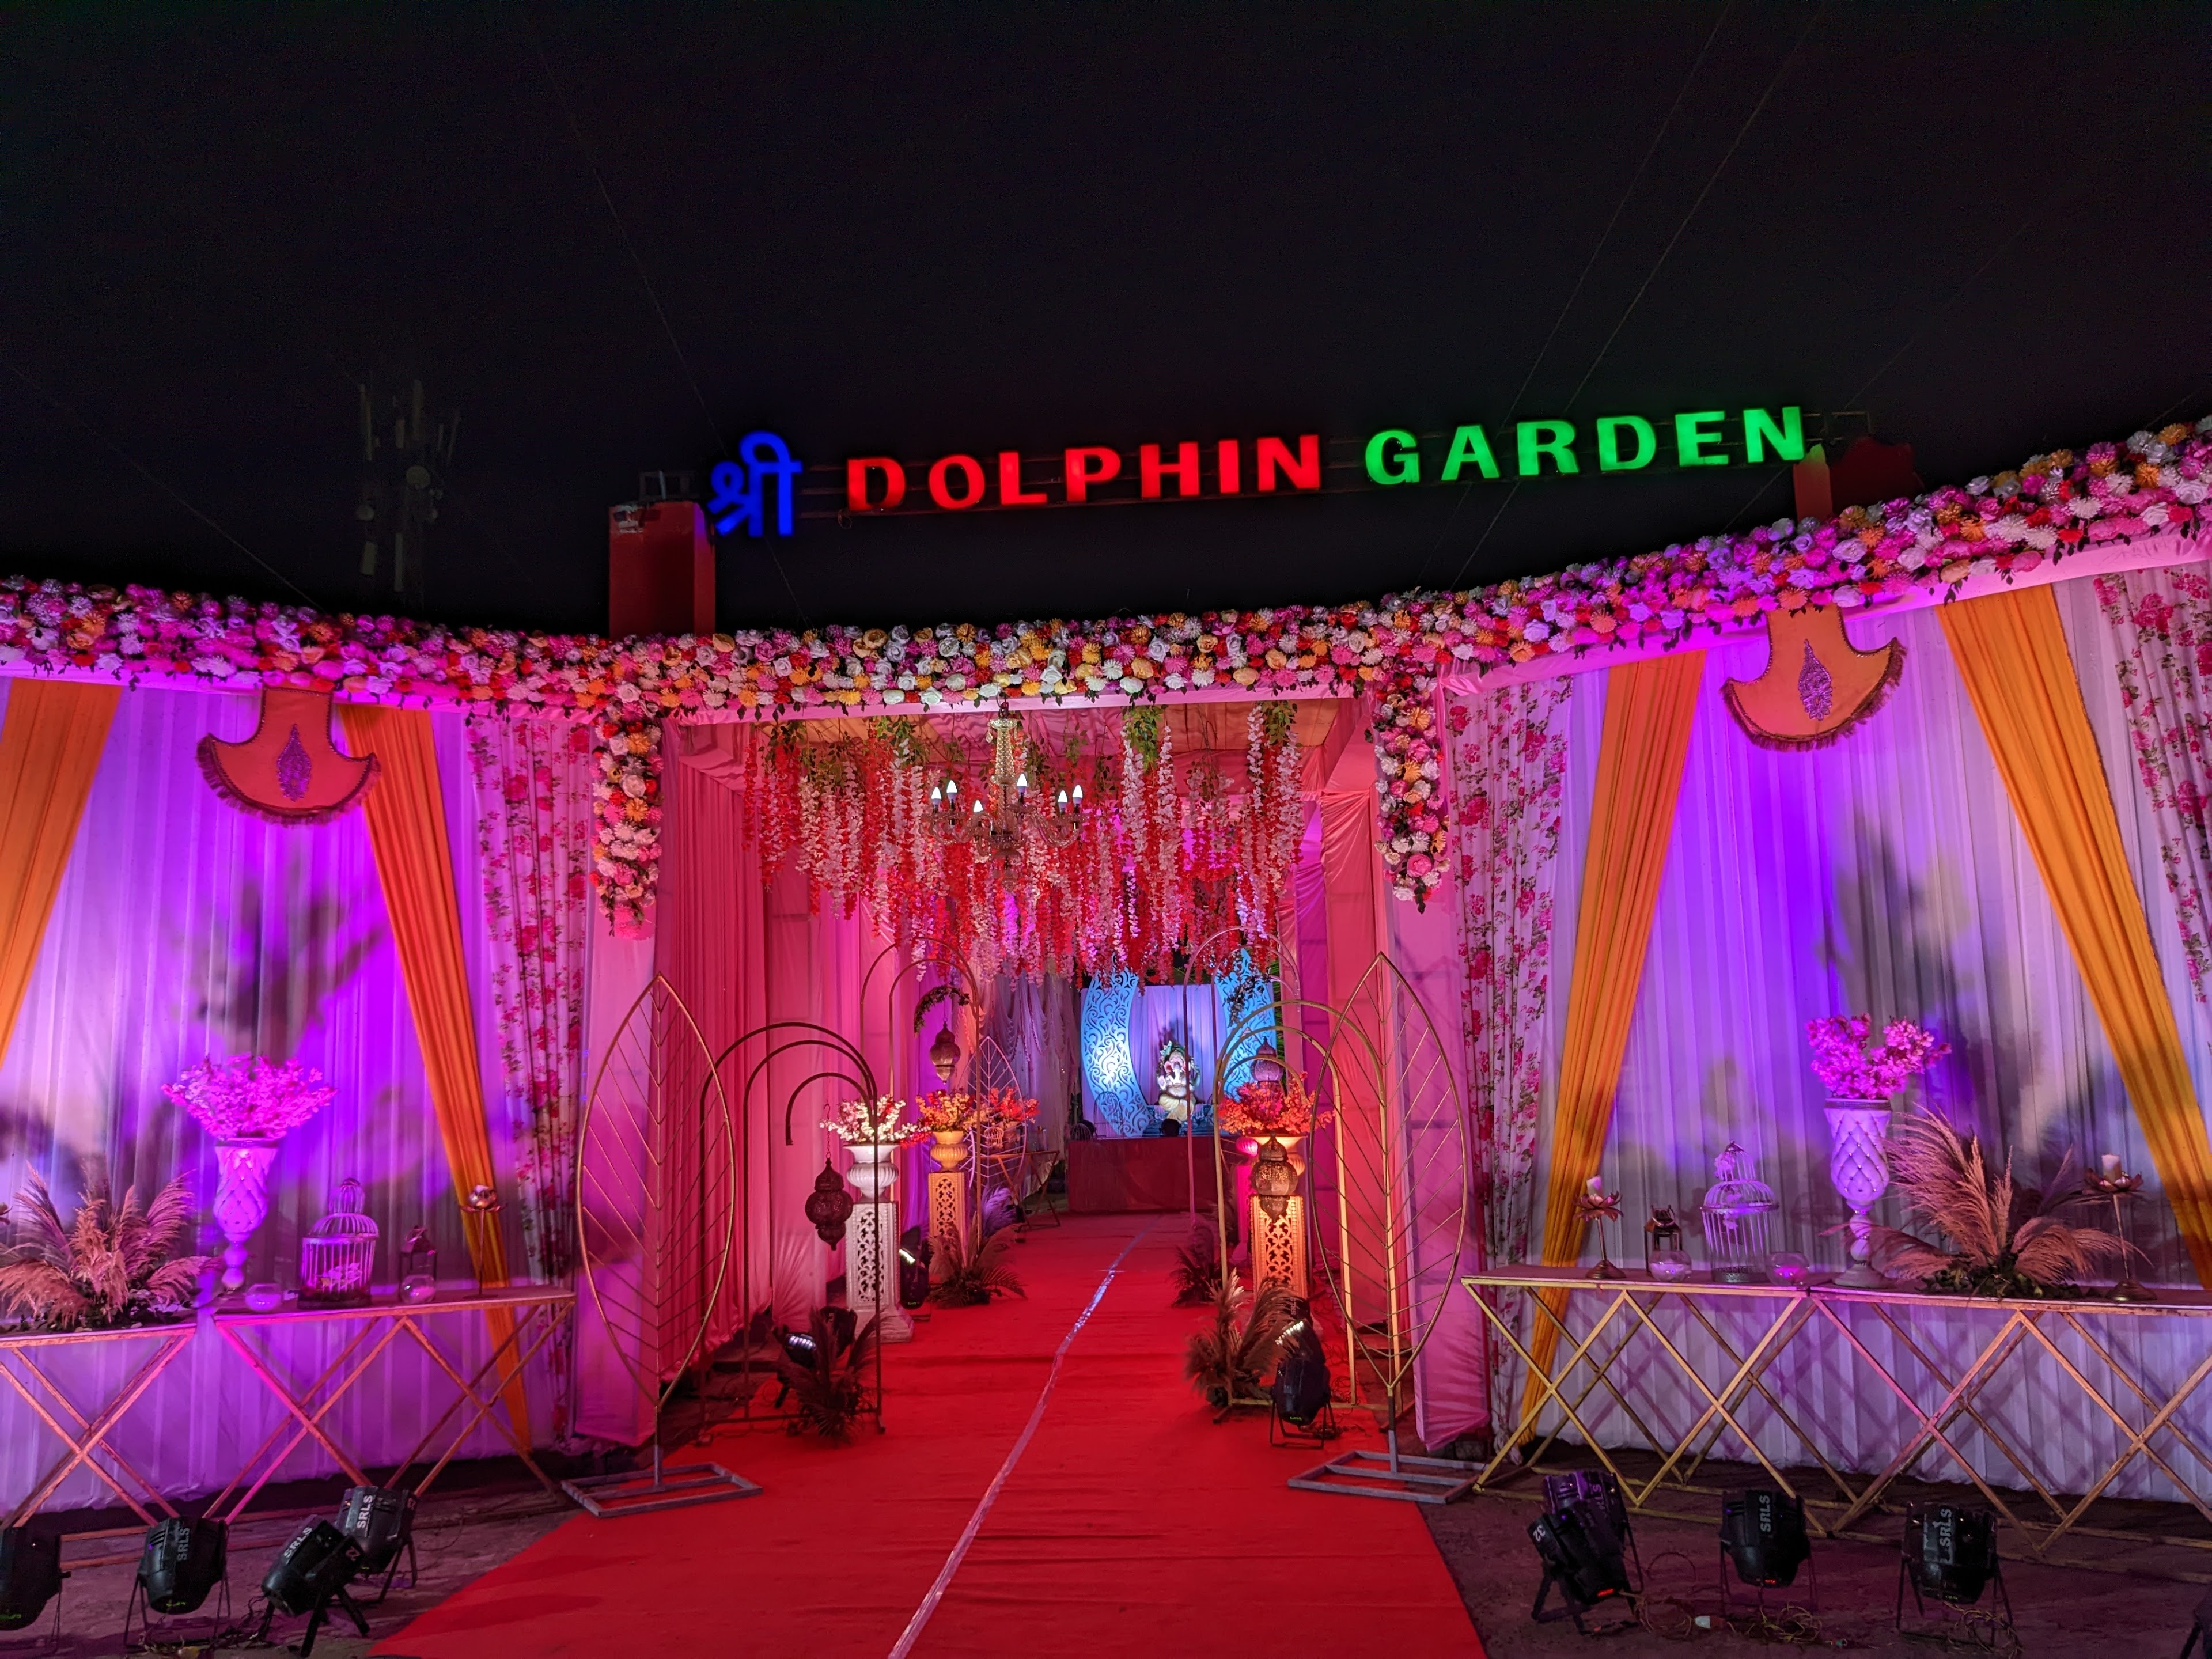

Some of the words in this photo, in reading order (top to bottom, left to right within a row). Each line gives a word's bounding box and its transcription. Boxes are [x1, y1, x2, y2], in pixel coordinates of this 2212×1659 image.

[708, 431, 802, 536] श्री
[847, 435, 1320, 510] DOLPHIN
[1365, 407, 1804, 484] GARDEN
[357, 1494, 373, 1529] SRLS
[1759, 1495, 1771, 1532] SRLS
[1939, 1508, 1952, 1547] SRLS
[177, 1527, 190, 1562] SRLS
[283, 1527, 312, 1558] SRLS
